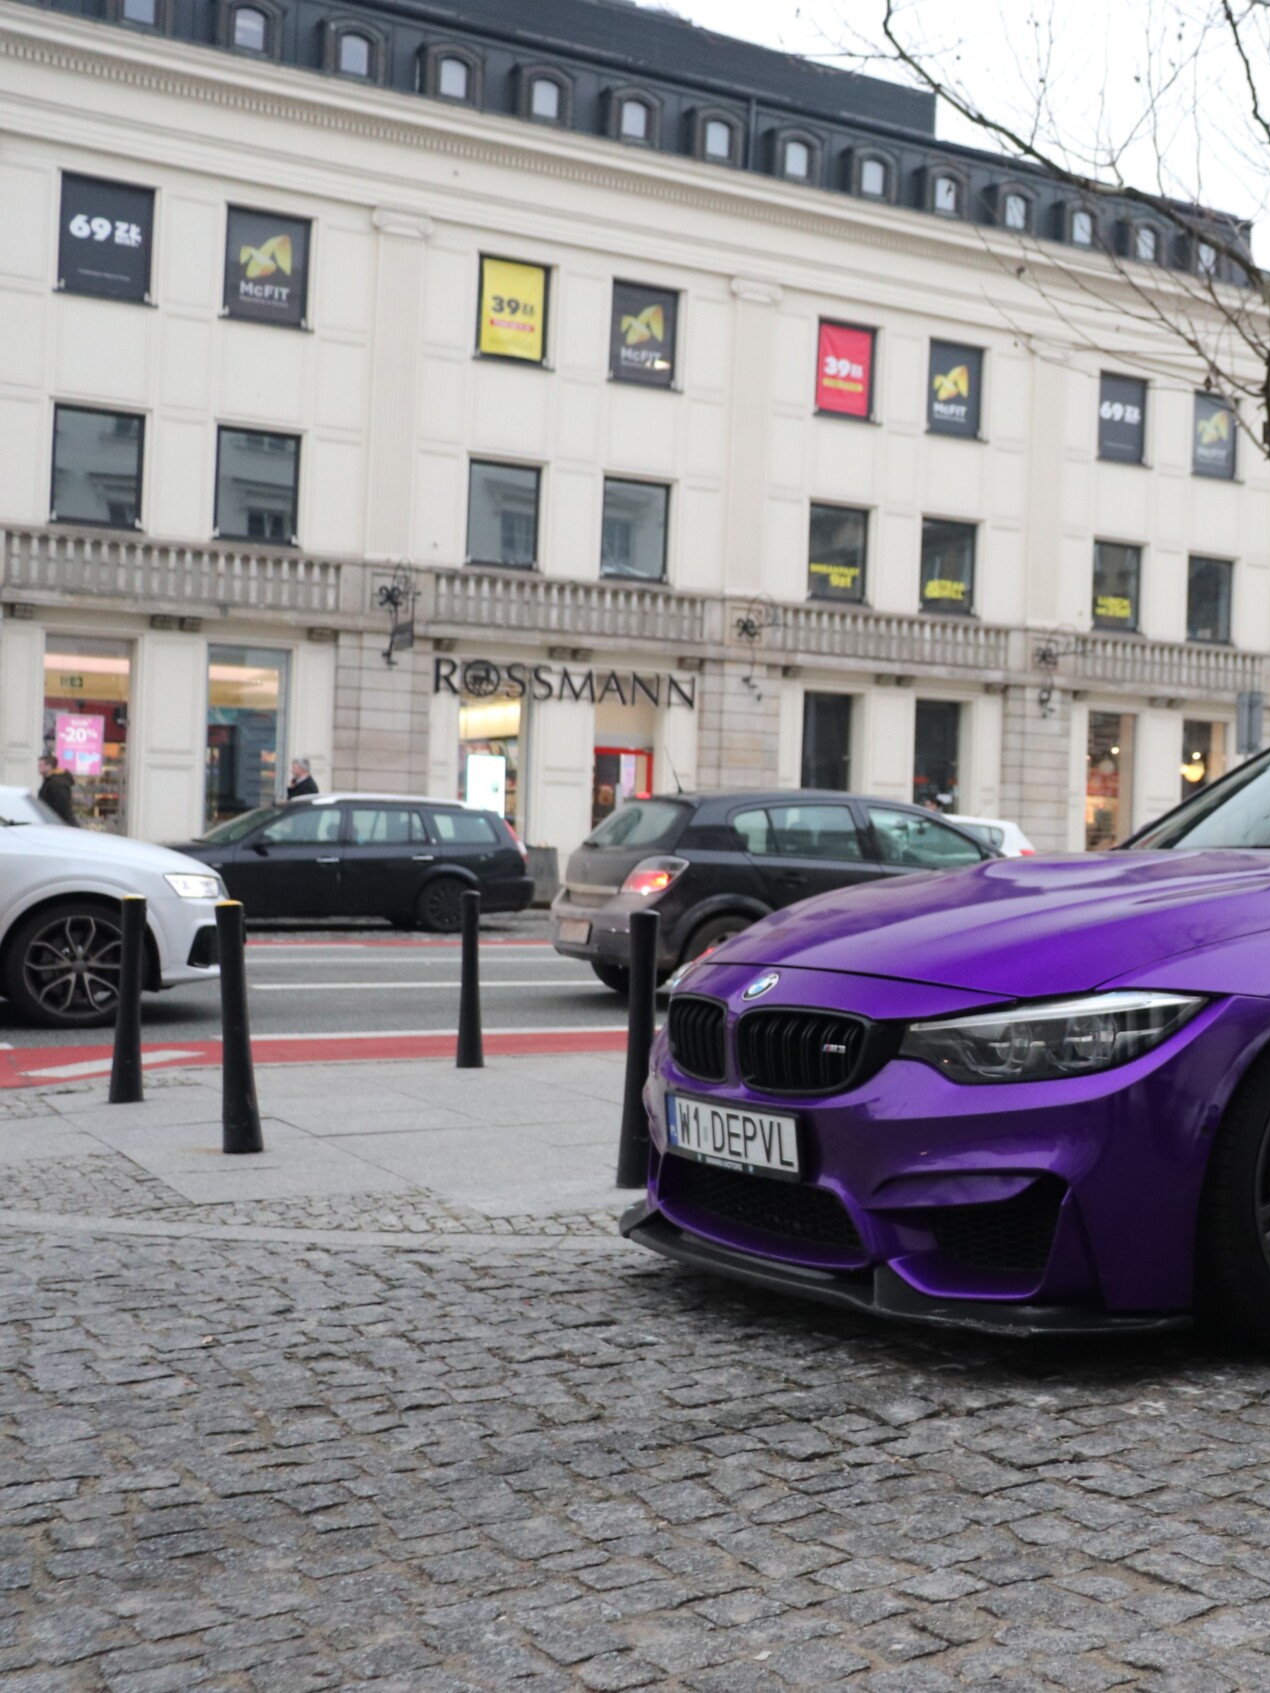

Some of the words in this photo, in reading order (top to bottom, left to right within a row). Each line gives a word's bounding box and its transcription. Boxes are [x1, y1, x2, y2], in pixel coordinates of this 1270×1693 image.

[69, 213, 112, 241] 69
[240, 280, 290, 300] McFIT
[491, 295, 520, 316] 39
[823, 355, 852, 378] 39
[1100, 400, 1124, 421] 69
[433, 656, 697, 709] ROSSMANN
[60, 725, 98, 743] -20%
[679, 1102, 700, 1150] W1
[710, 1109, 795, 1168] DEPVL
